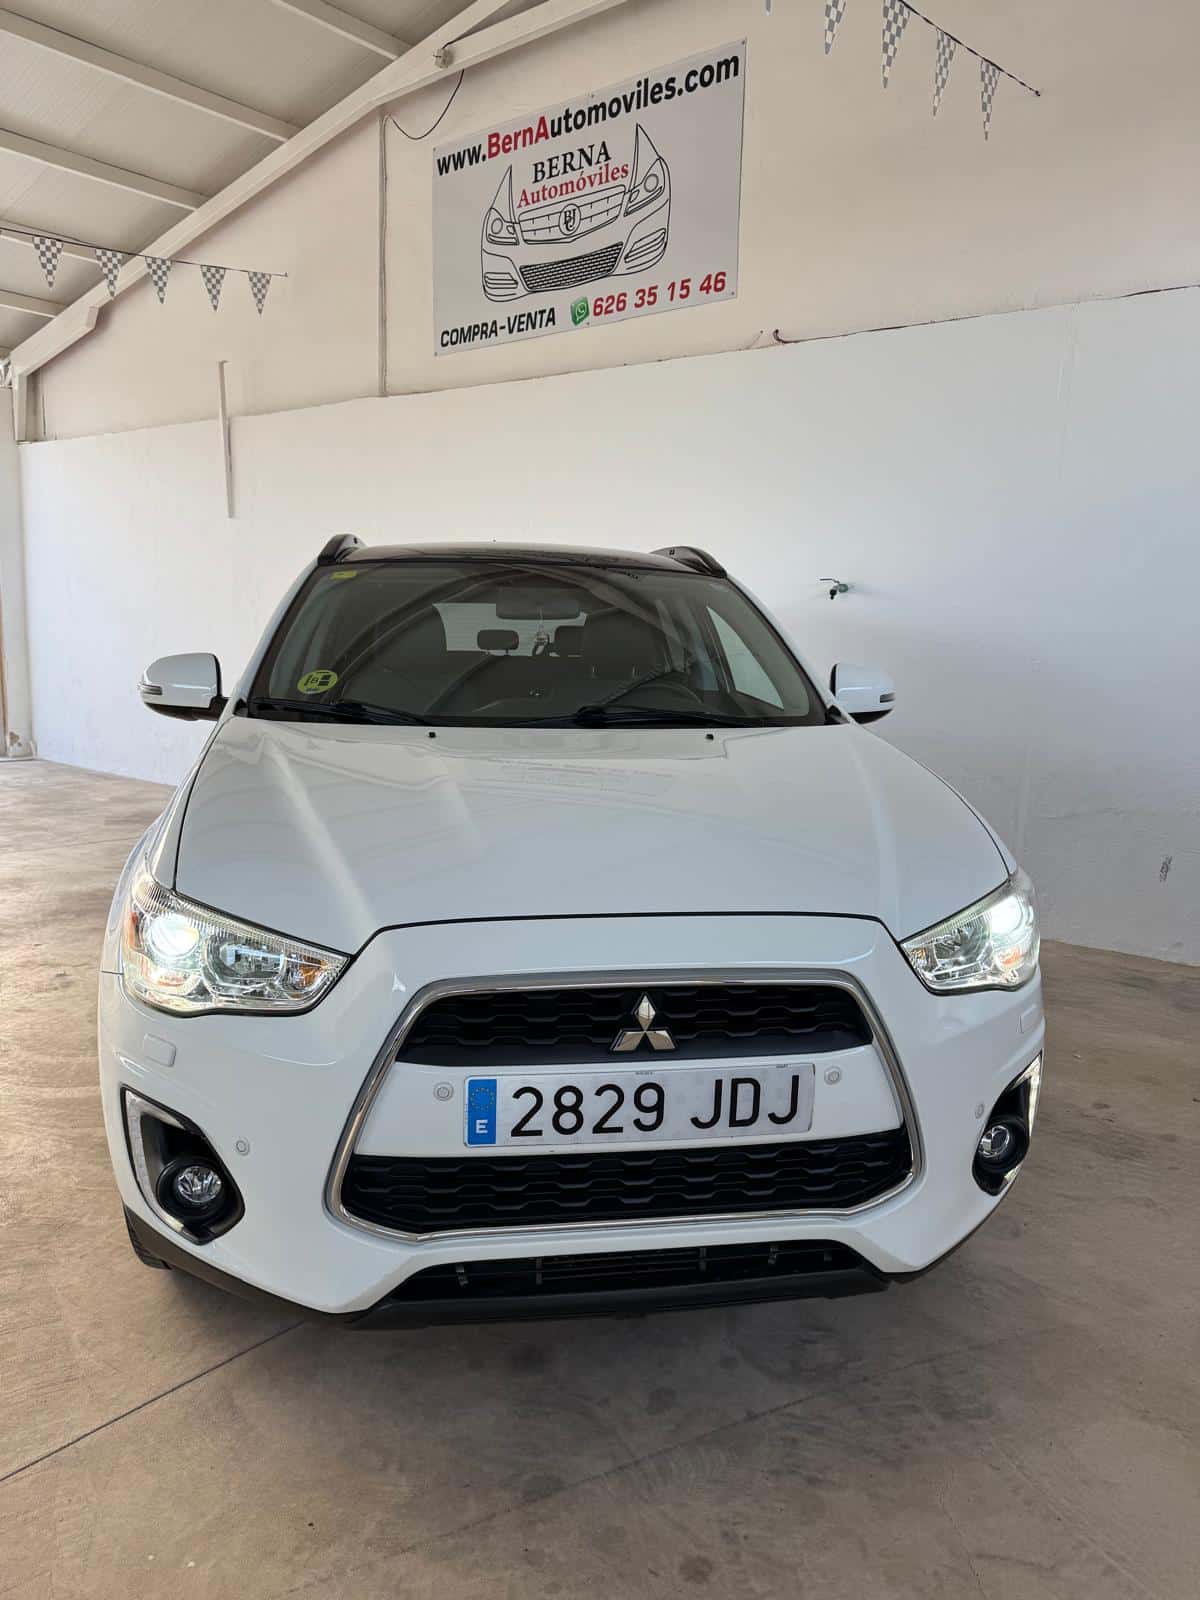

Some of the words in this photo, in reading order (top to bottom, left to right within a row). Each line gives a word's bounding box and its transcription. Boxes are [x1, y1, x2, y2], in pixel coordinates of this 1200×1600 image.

[436, 54, 739, 176] www.BernAutomoviles.com
[532, 140, 612, 184] BERNA
[517, 162, 629, 208] Automóviles
[592, 292, 627, 316] 626
[634, 285, 658, 308] 35
[667, 278, 691, 301] 15
[699, 271, 727, 294] 46
[440, 307, 556, 347] COMPRA-VENTA
[475, 1119, 488, 1134] E
[510, 1081, 665, 1137] 2829
[690, 1074, 800, 1129] JDJ
